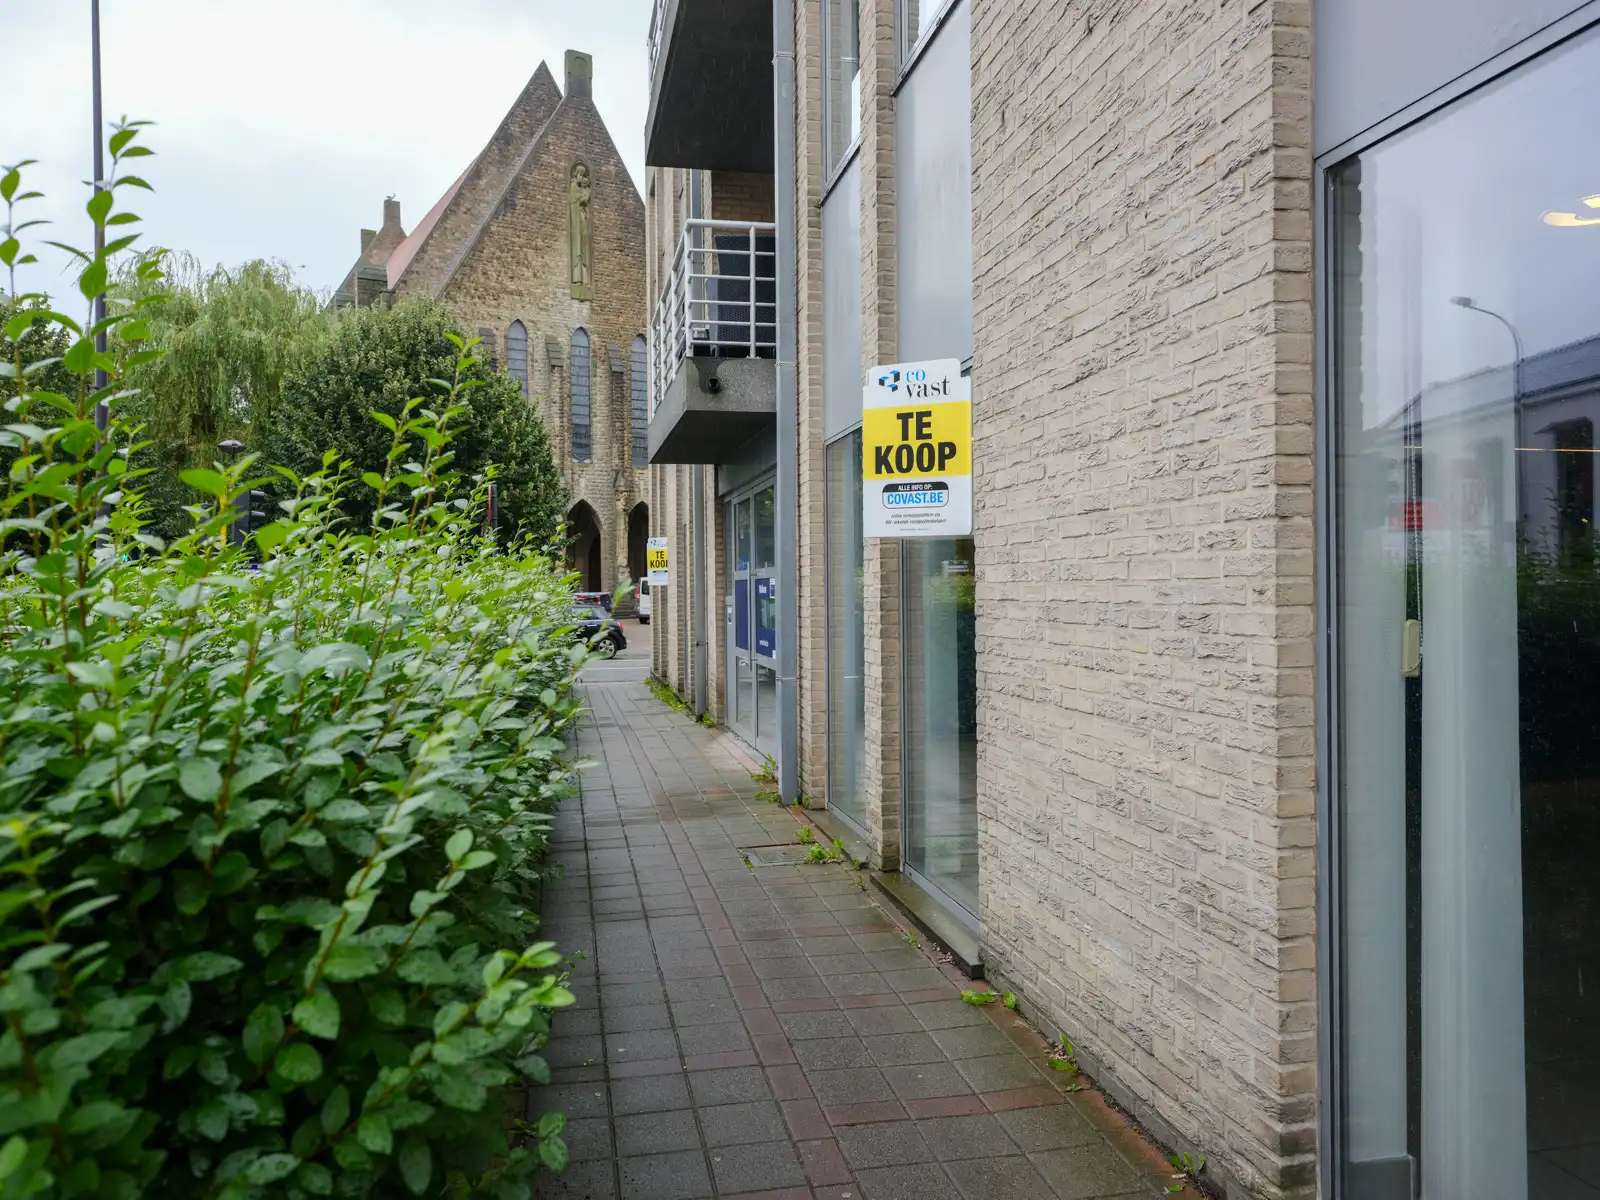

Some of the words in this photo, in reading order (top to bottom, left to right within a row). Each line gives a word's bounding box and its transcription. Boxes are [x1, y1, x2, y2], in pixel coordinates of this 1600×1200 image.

[906, 369, 926, 383] co
[906, 375, 951, 398] vast
[896, 410, 932, 441] TE
[874, 441, 957, 475] KOOP
[887, 491, 944, 505] COVAST.BE
[655, 550, 665, 559] TE
